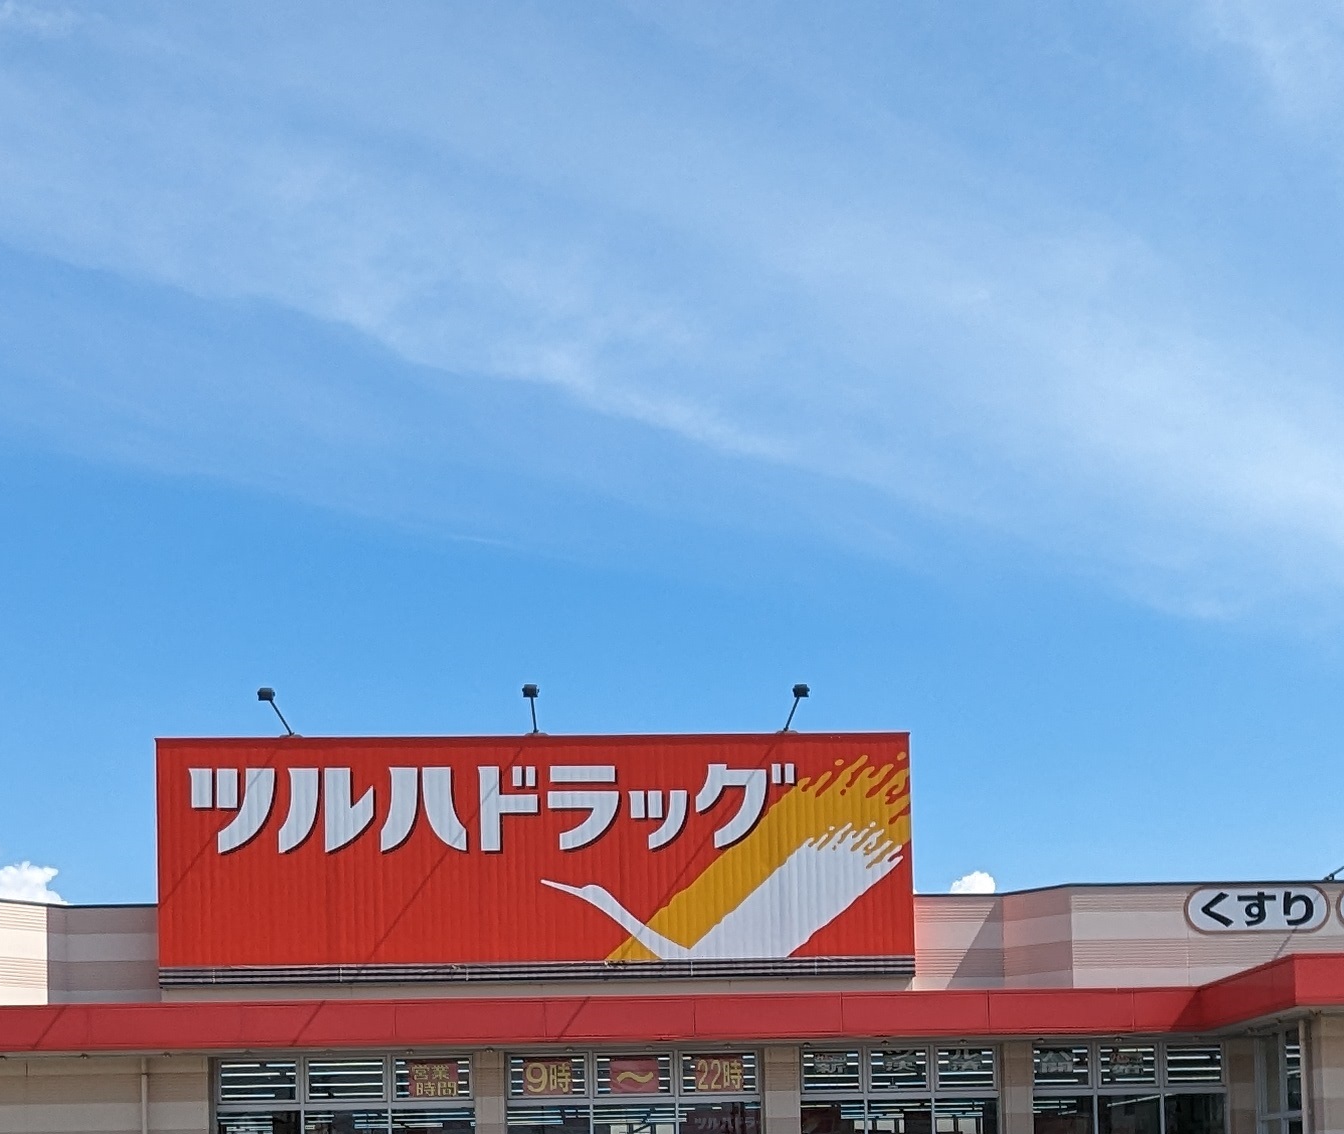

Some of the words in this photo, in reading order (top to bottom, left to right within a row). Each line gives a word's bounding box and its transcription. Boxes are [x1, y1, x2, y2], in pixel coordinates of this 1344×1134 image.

[188, 762, 796, 855] ツルハドラッグ
[1201, 891, 1314, 928] くすり
[412, 1065, 449, 1080] 営業
[417, 1081, 456, 1096] 時間
[526, 1062, 572, 1093] 9時
[697, 1059, 743, 1090] 22時
